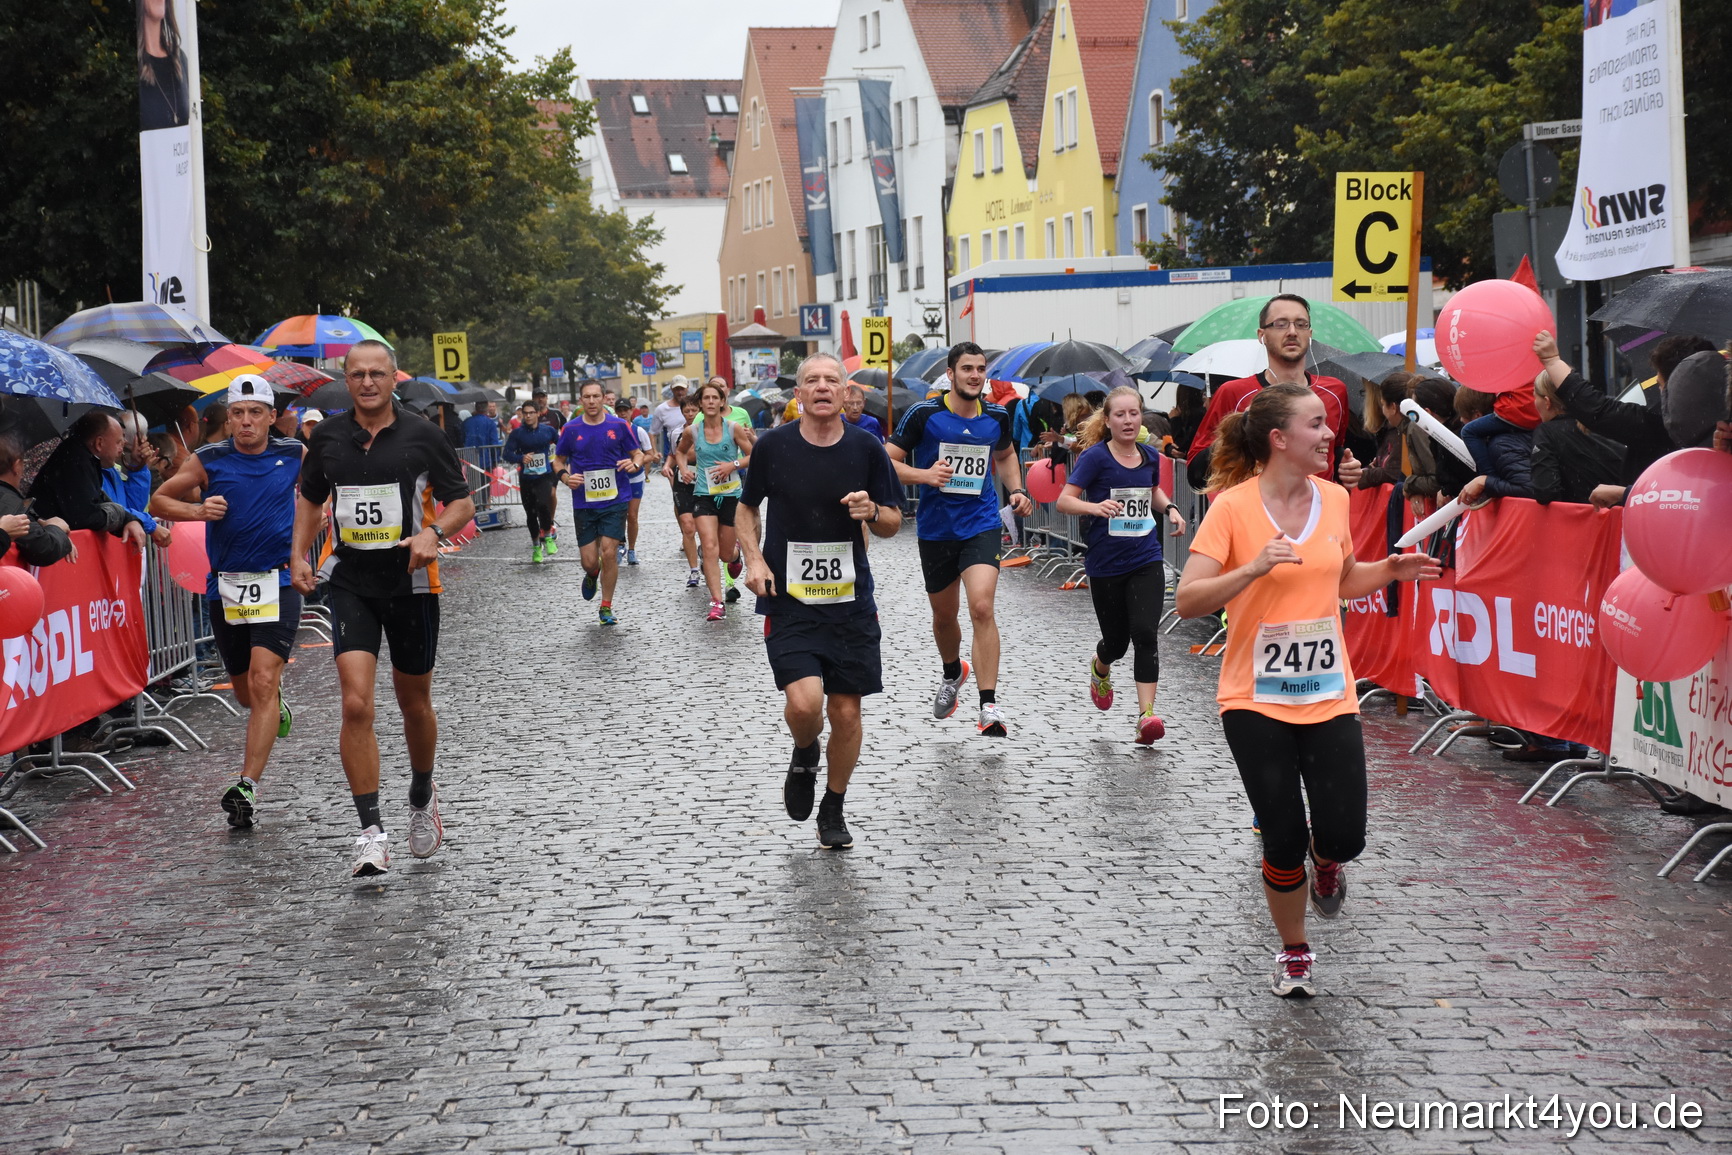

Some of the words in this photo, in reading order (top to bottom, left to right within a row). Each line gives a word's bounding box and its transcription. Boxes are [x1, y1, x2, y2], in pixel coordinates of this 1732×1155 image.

[1536, 125, 1559, 136] Ulmer
[1562, 123, 1582, 134] Gass
[803, 156, 828, 211] K&L
[1346, 178, 1412, 200] Block
[985, 199, 1006, 222] HOTEL
[1355, 211, 1399, 274] C
[865, 318, 889, 328] Block
[437, 335, 463, 344] Block
[870, 332, 885, 356] D
[443, 348, 460, 371] D
[590, 477, 611, 490] 303
[949, 479, 974, 487] Florian
[355, 502, 383, 525] 55
[1659, 502, 1700, 511] energie
[352, 531, 390, 541] Matthias
[816, 544, 848, 553] BOCK
[801, 558, 843, 581] 258
[236, 583, 261, 603] 79
[805, 587, 838, 595] Herbert
[237, 608, 260, 617] Stefan
[1295, 620, 1333, 635] BOCK
[1264, 639, 1335, 672] 2473
[1281, 680, 1320, 693] Amelie
